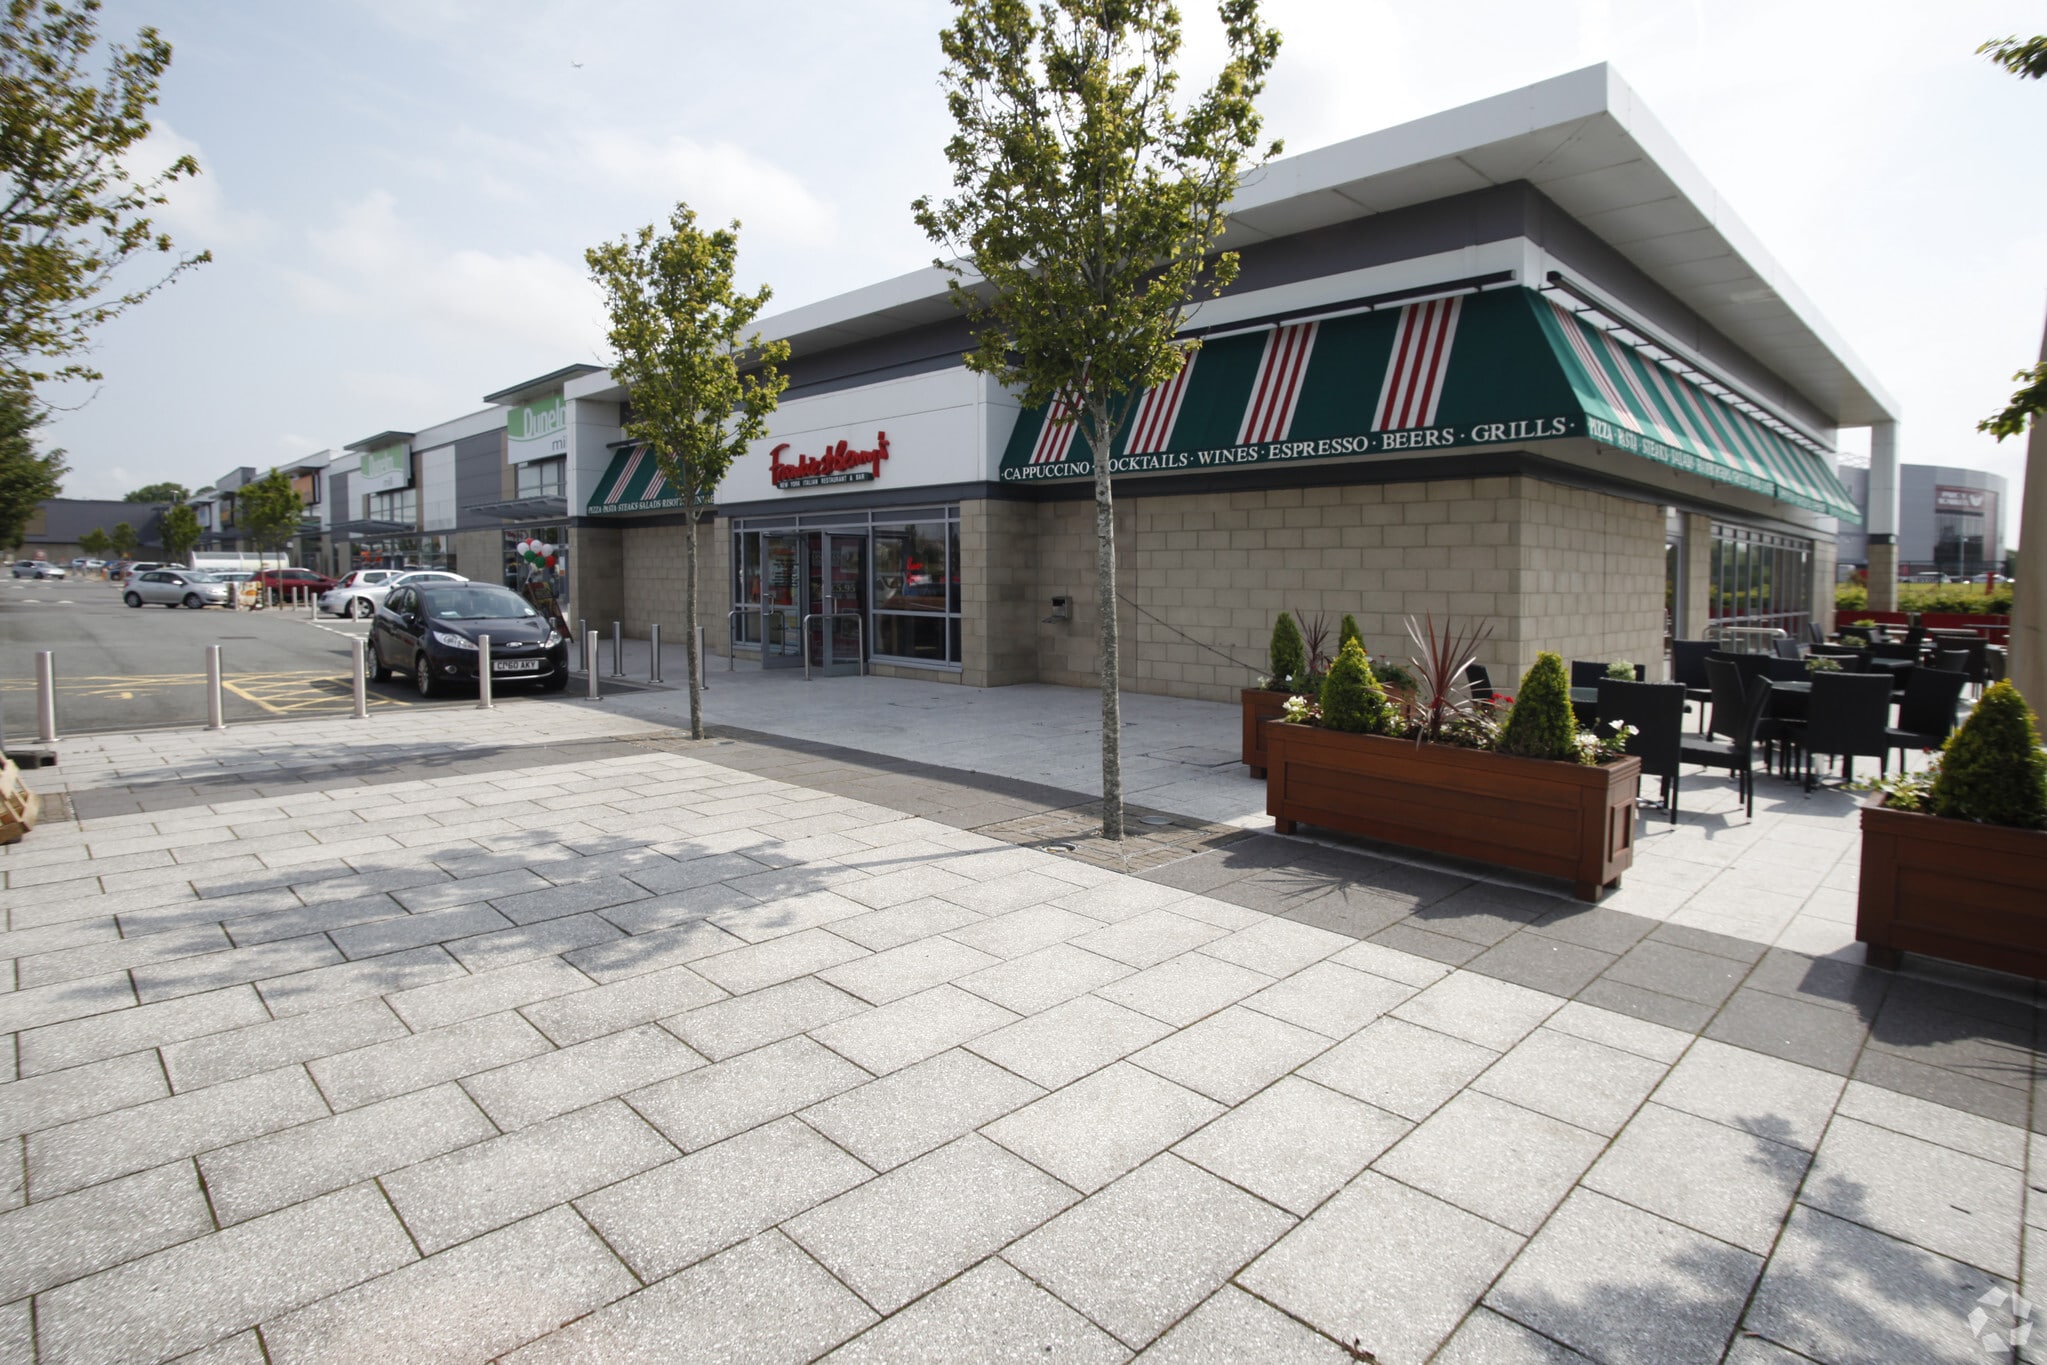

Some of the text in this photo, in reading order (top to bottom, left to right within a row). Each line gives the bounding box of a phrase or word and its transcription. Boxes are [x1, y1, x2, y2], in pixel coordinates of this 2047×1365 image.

[1589, 416, 1614, 442] PIZZA
[1004, 417, 1567, 480] CAPPUCCINO OCKTAILS WINES ESPRESSO BEERS GRILLS
[790, 480, 801, 488] YORK
[802, 478, 818, 486] ITALIAN
[821, 474, 847, 484] RESTAURANT
[588, 505, 601, 514] PIZZA
[603, 504, 617, 513] PASTA
[618, 502, 638, 512] STEAKS
[640, 500, 660, 510] SALADS
[520, 660, 536, 669] AKY
